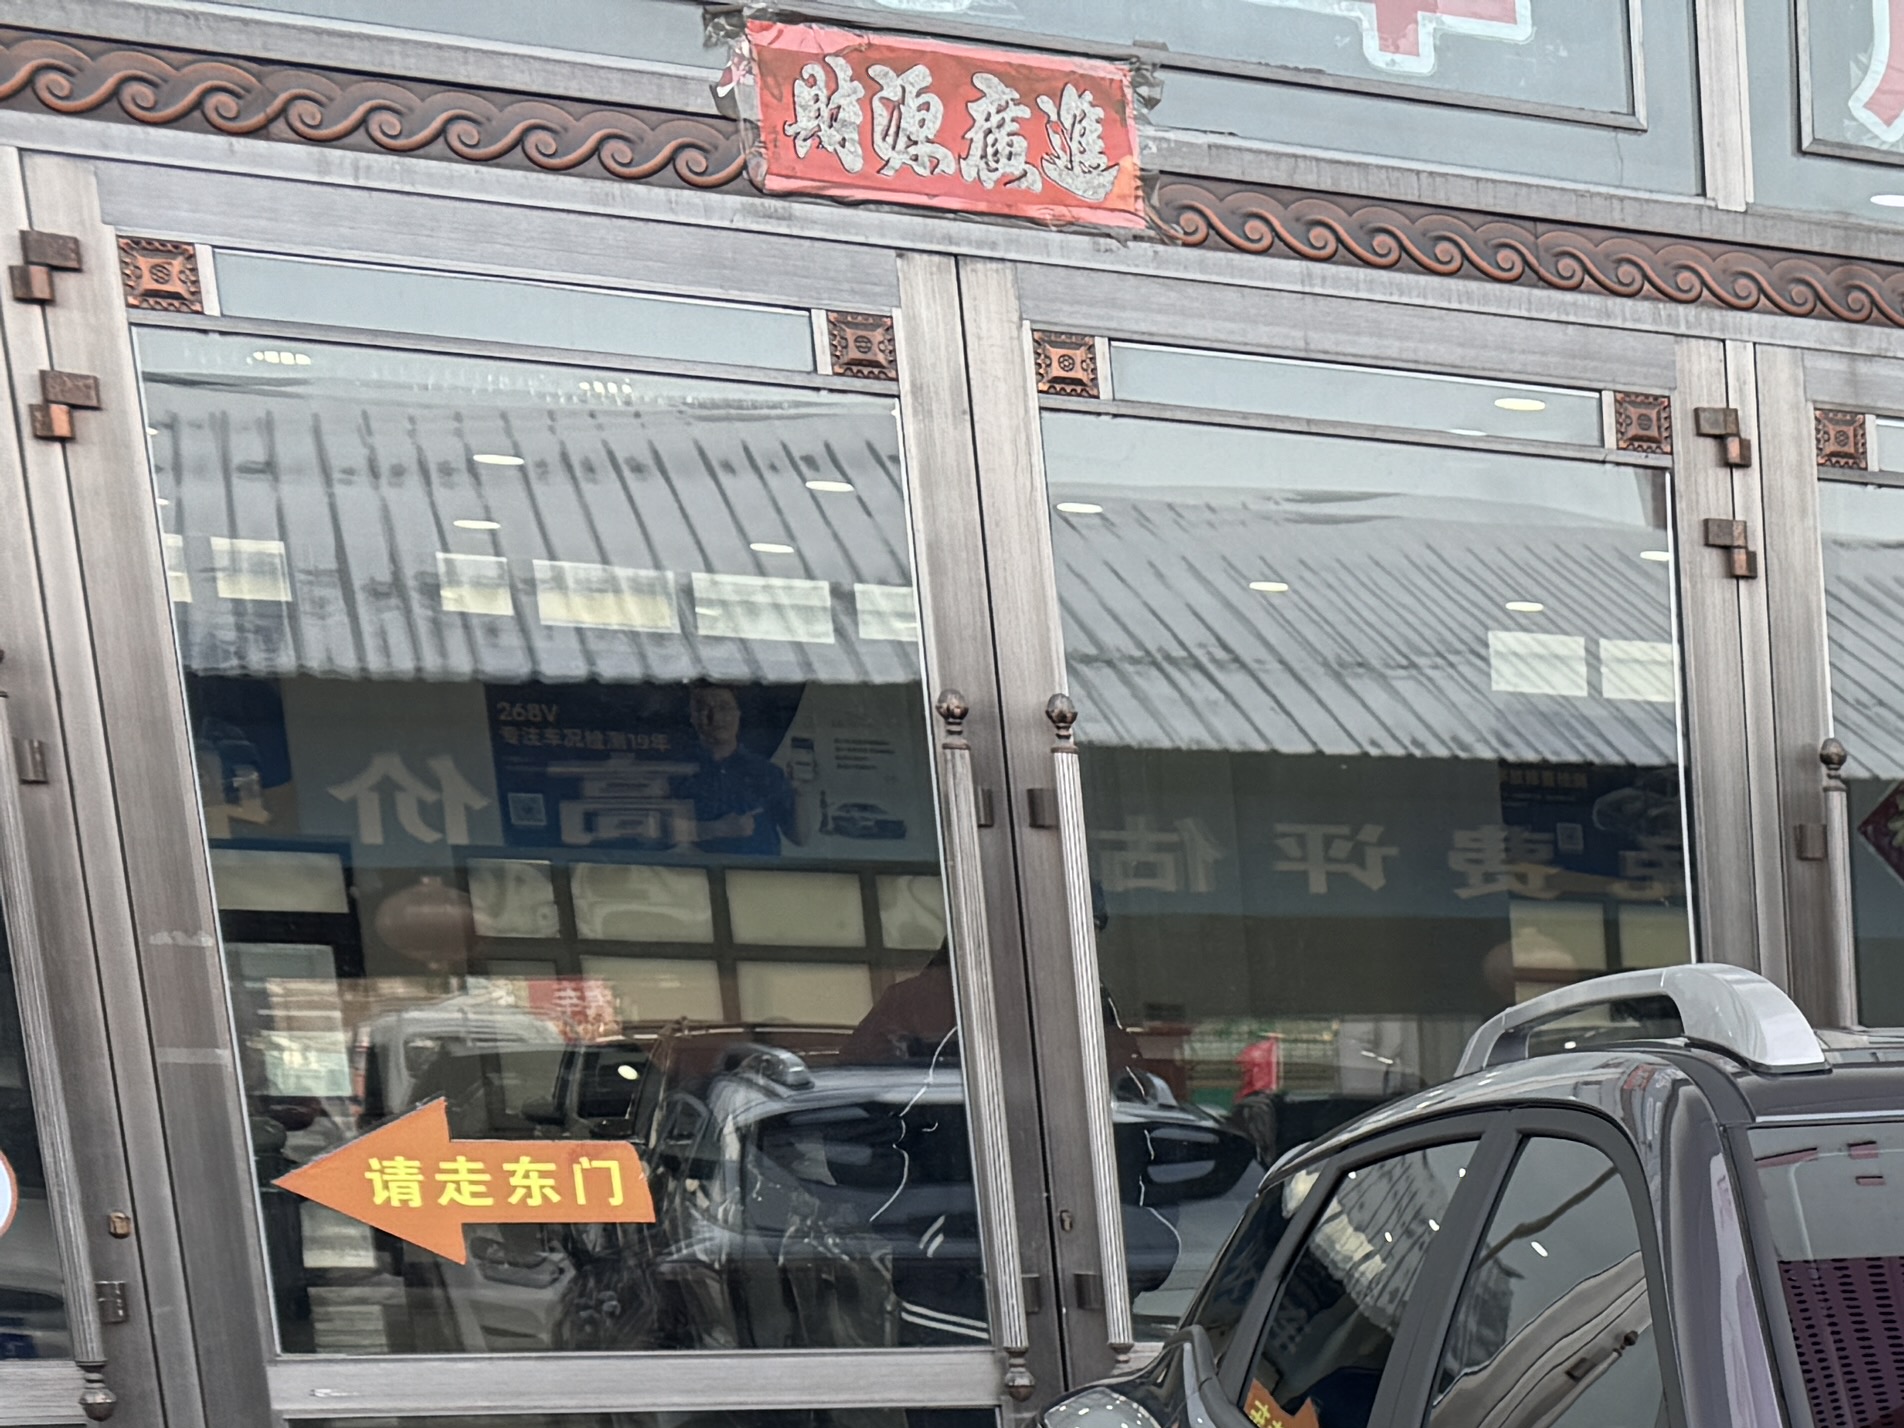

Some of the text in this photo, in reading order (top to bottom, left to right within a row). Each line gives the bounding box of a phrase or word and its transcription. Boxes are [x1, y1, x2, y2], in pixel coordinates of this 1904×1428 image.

[783, 54, 1120, 201] 財源廣進
[497, 702, 558, 722] 268V
[364, 1155, 624, 1207] 请走东门
